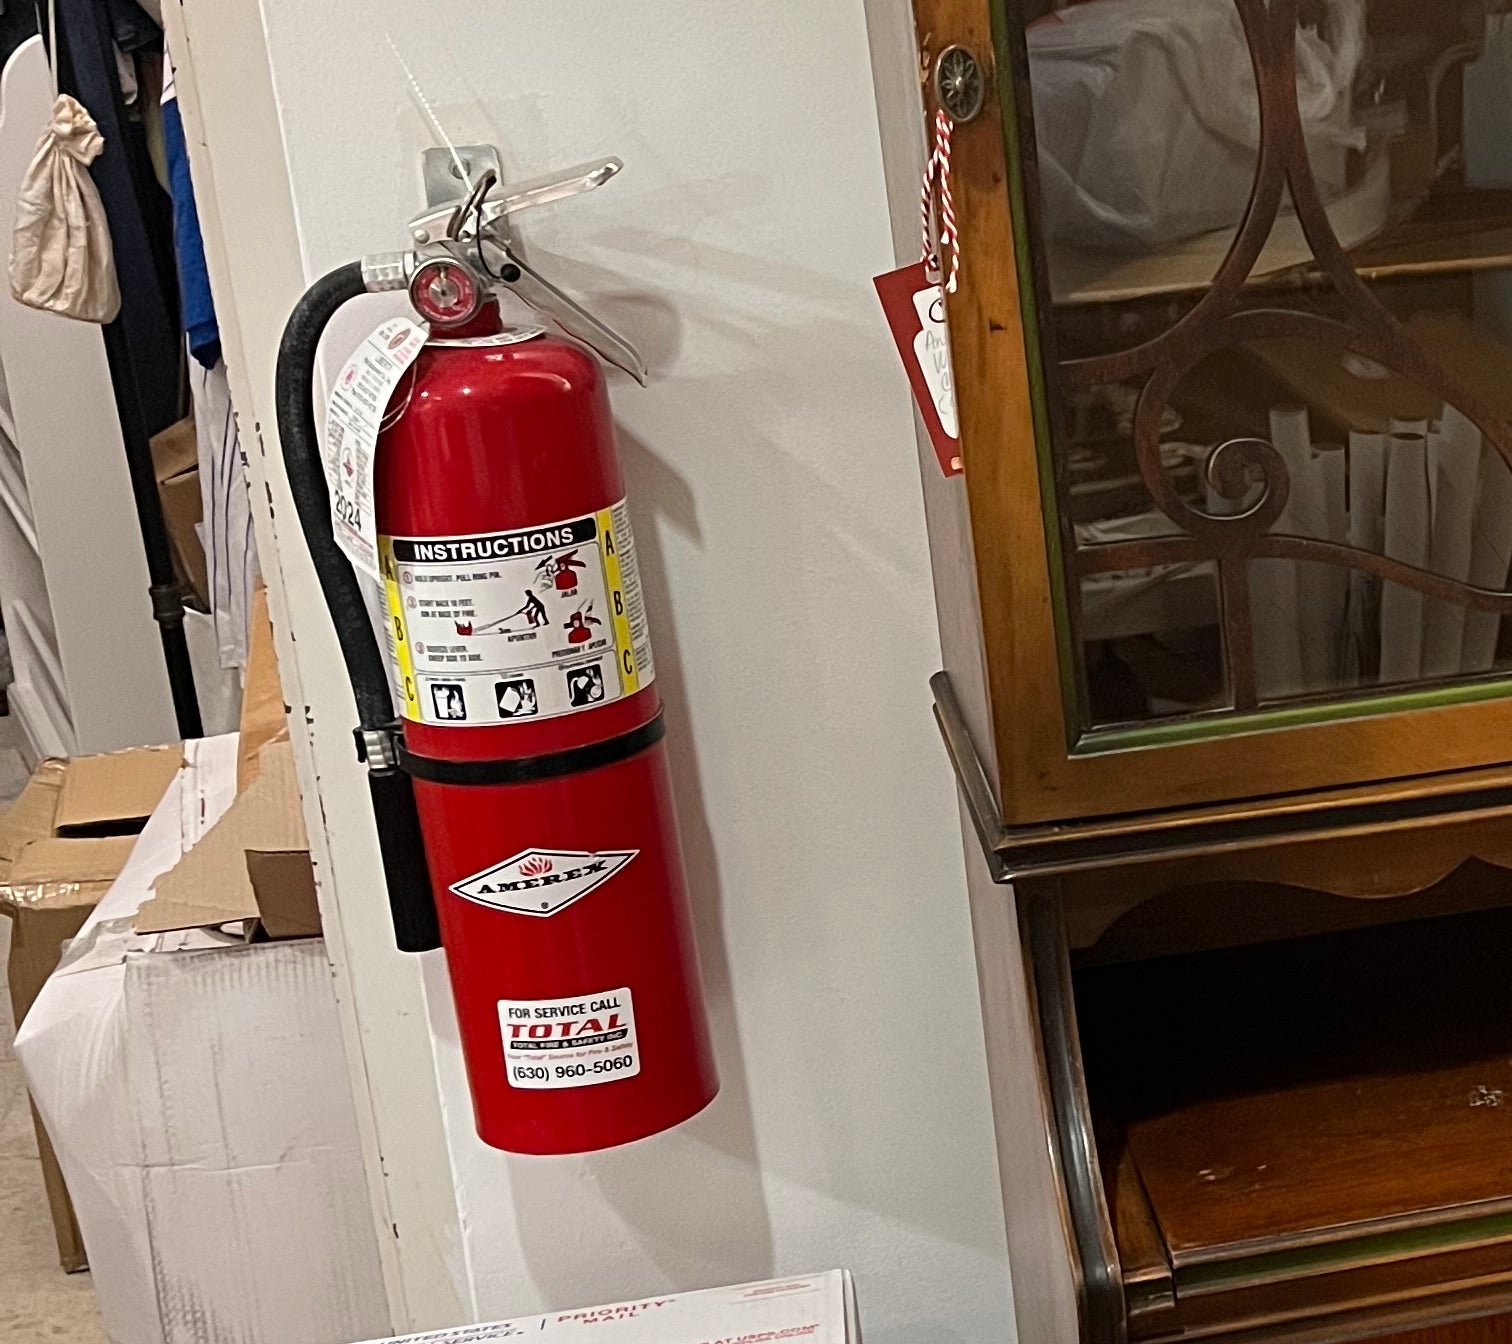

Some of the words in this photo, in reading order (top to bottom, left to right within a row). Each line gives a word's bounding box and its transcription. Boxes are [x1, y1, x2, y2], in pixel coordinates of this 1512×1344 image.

[412, 527, 574, 561] INSTRUCTIONS
[604, 529, 616, 556] A
[613, 590, 623, 616] B
[393, 615, 404, 642] B
[623, 649, 633, 674] C
[405, 676, 415, 702] C
[477, 859, 609, 895] AMEREX
[508, 1007, 531, 1019] FOR
[534, 1003, 587, 1019] SERVICE
[590, 996, 622, 1013] CALL
[507, 1013, 627, 1039] TOTAL
[512, 1066, 549, 1082] (630)
[555, 1054, 633, 1080] 960-5060
